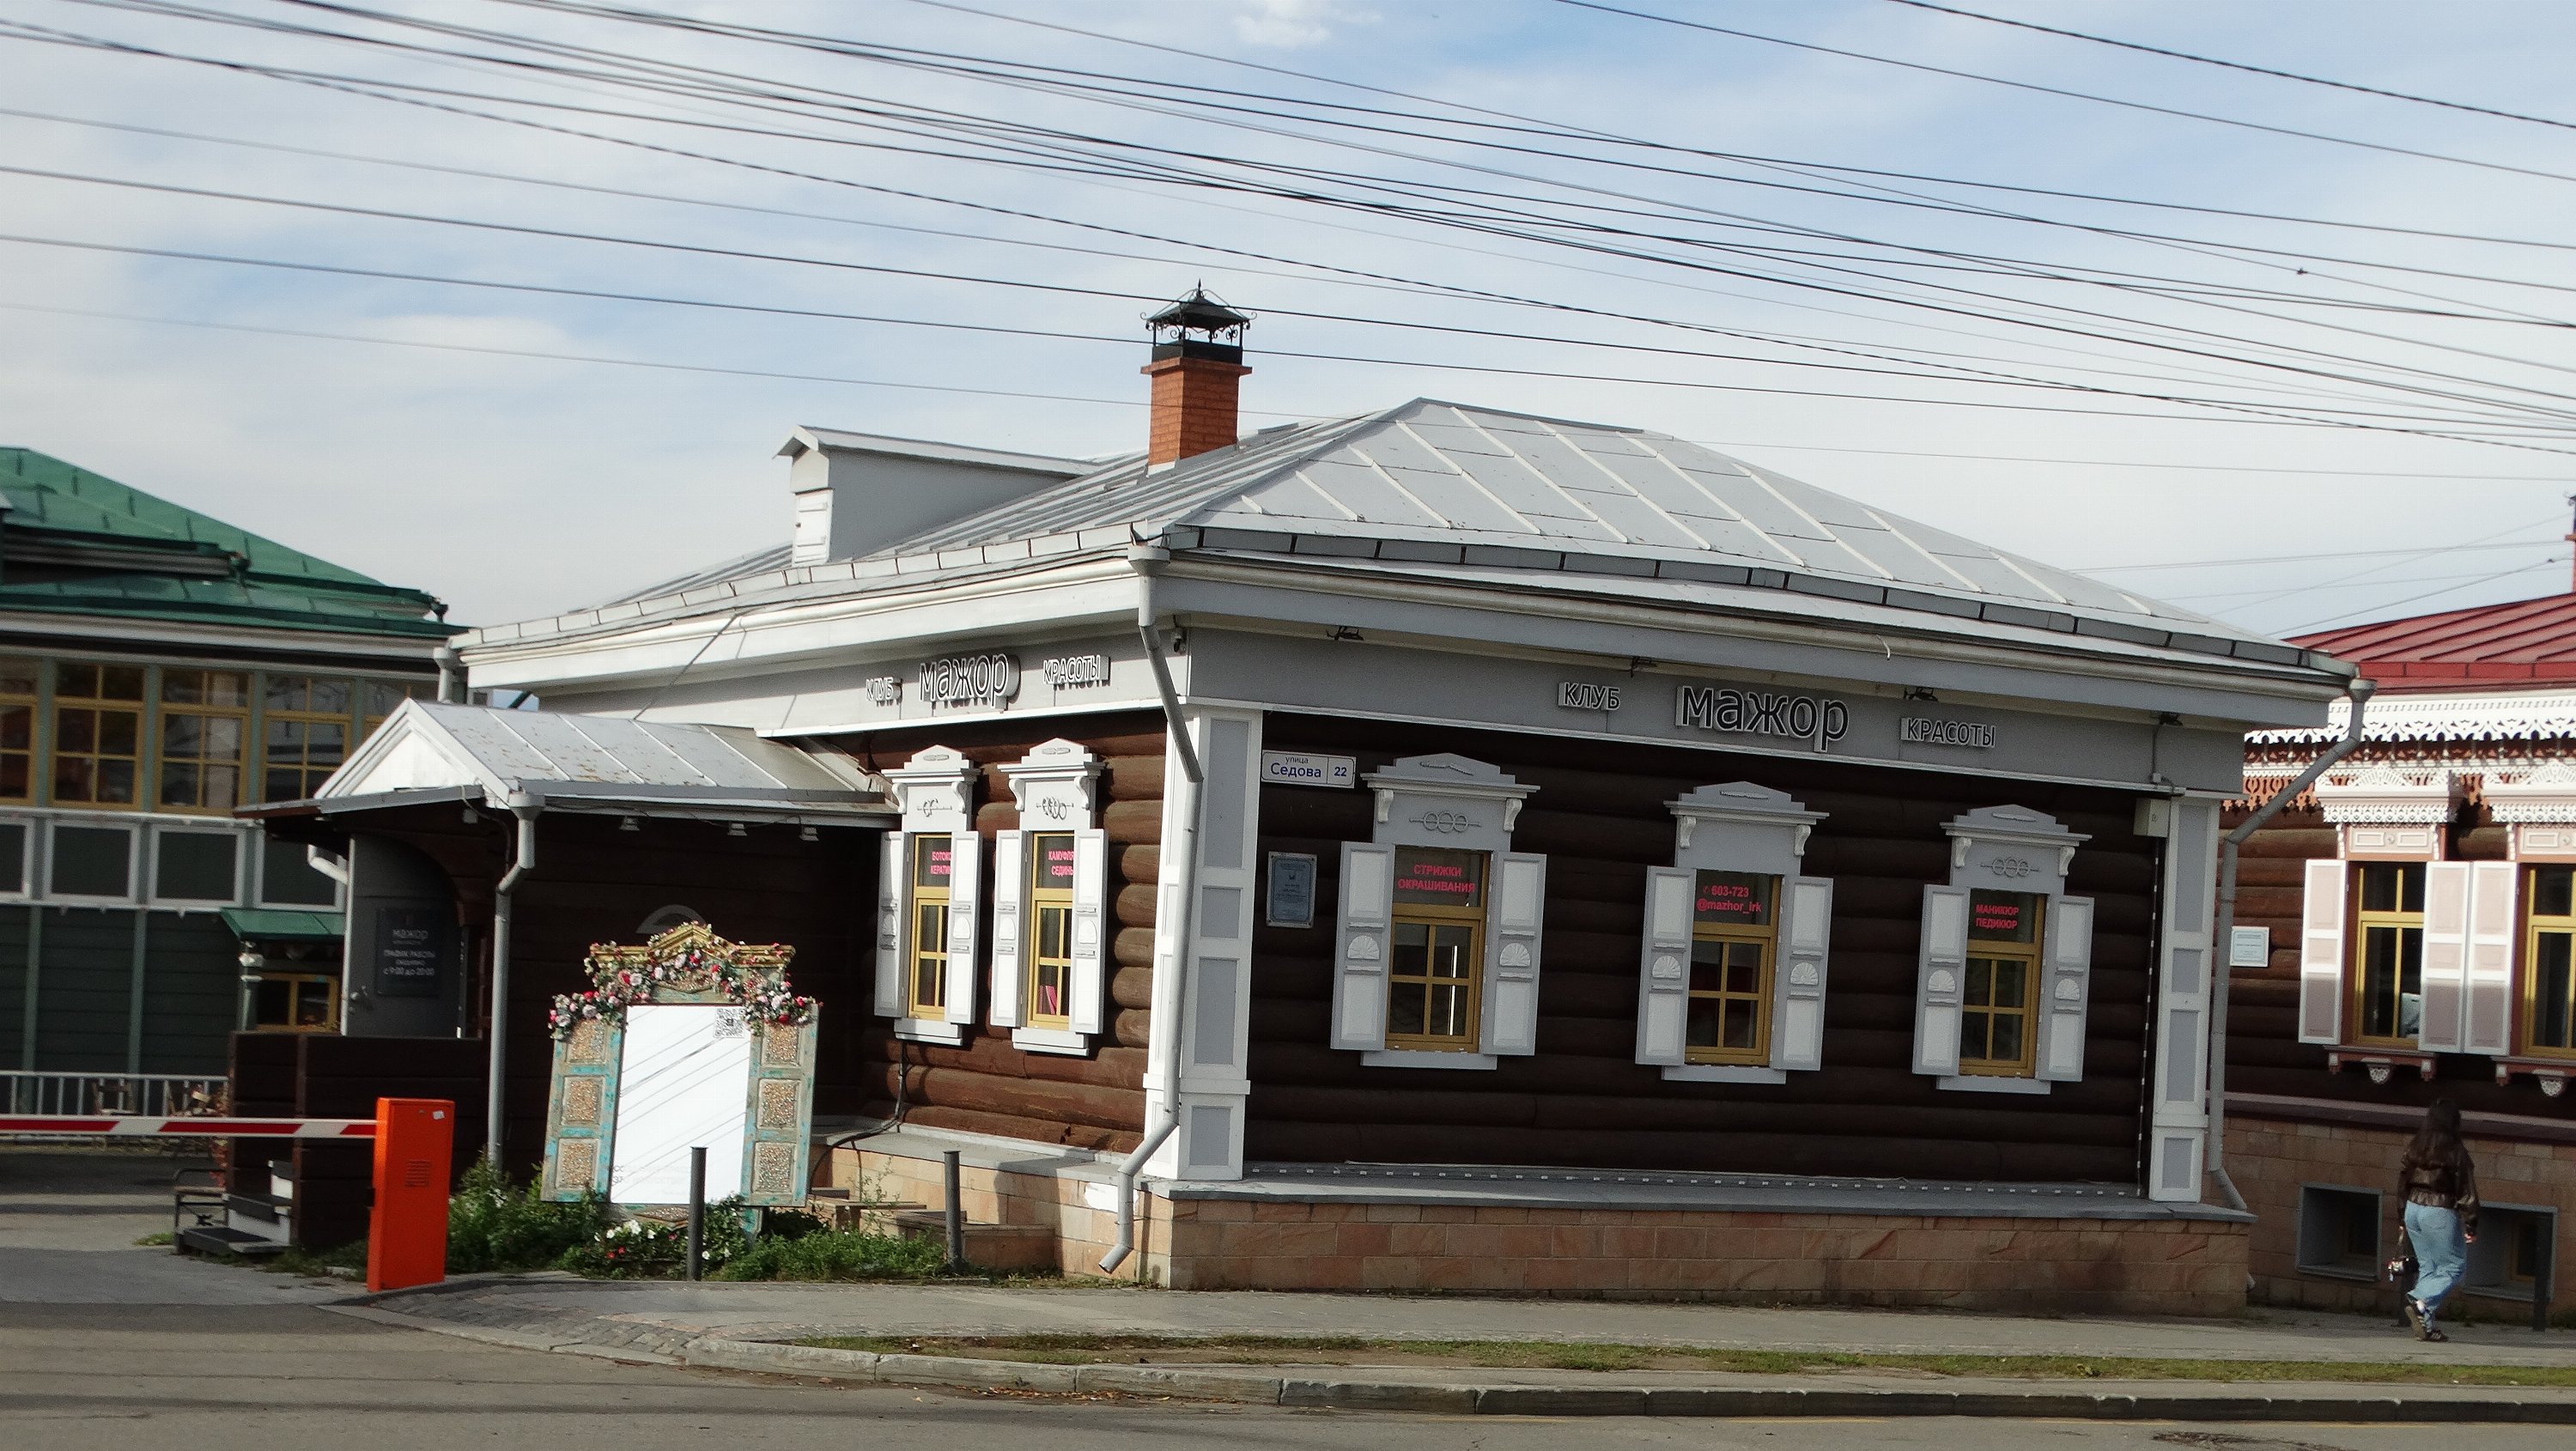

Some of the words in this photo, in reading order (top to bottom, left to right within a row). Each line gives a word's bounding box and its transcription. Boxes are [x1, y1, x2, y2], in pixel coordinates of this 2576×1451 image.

[866, 677, 895, 701] КЛУБ
[920, 653, 1009, 709] мажор
[1042, 654, 1102, 684] КРАСОТЫ
[1562, 683, 1620, 711] КЛУБ
[1680, 685, 1850, 750] мажор
[1906, 718, 1996, 747] КРАСОТЫ
[1285, 756, 1309, 765] улица
[1270, 762, 1322, 779] Седова
[1334, 766, 1347, 777] 22
[1413, 864, 1462, 877] СТРИЖКИ
[1398, 878, 1476, 893] ОКРАШИВАНИЯ
[1697, 898, 1762, 914] @mazhor_irk
[1976, 904, 2020, 916] МАНИКЮР
[1975, 917, 2018, 929] ПЕДИКЮР
